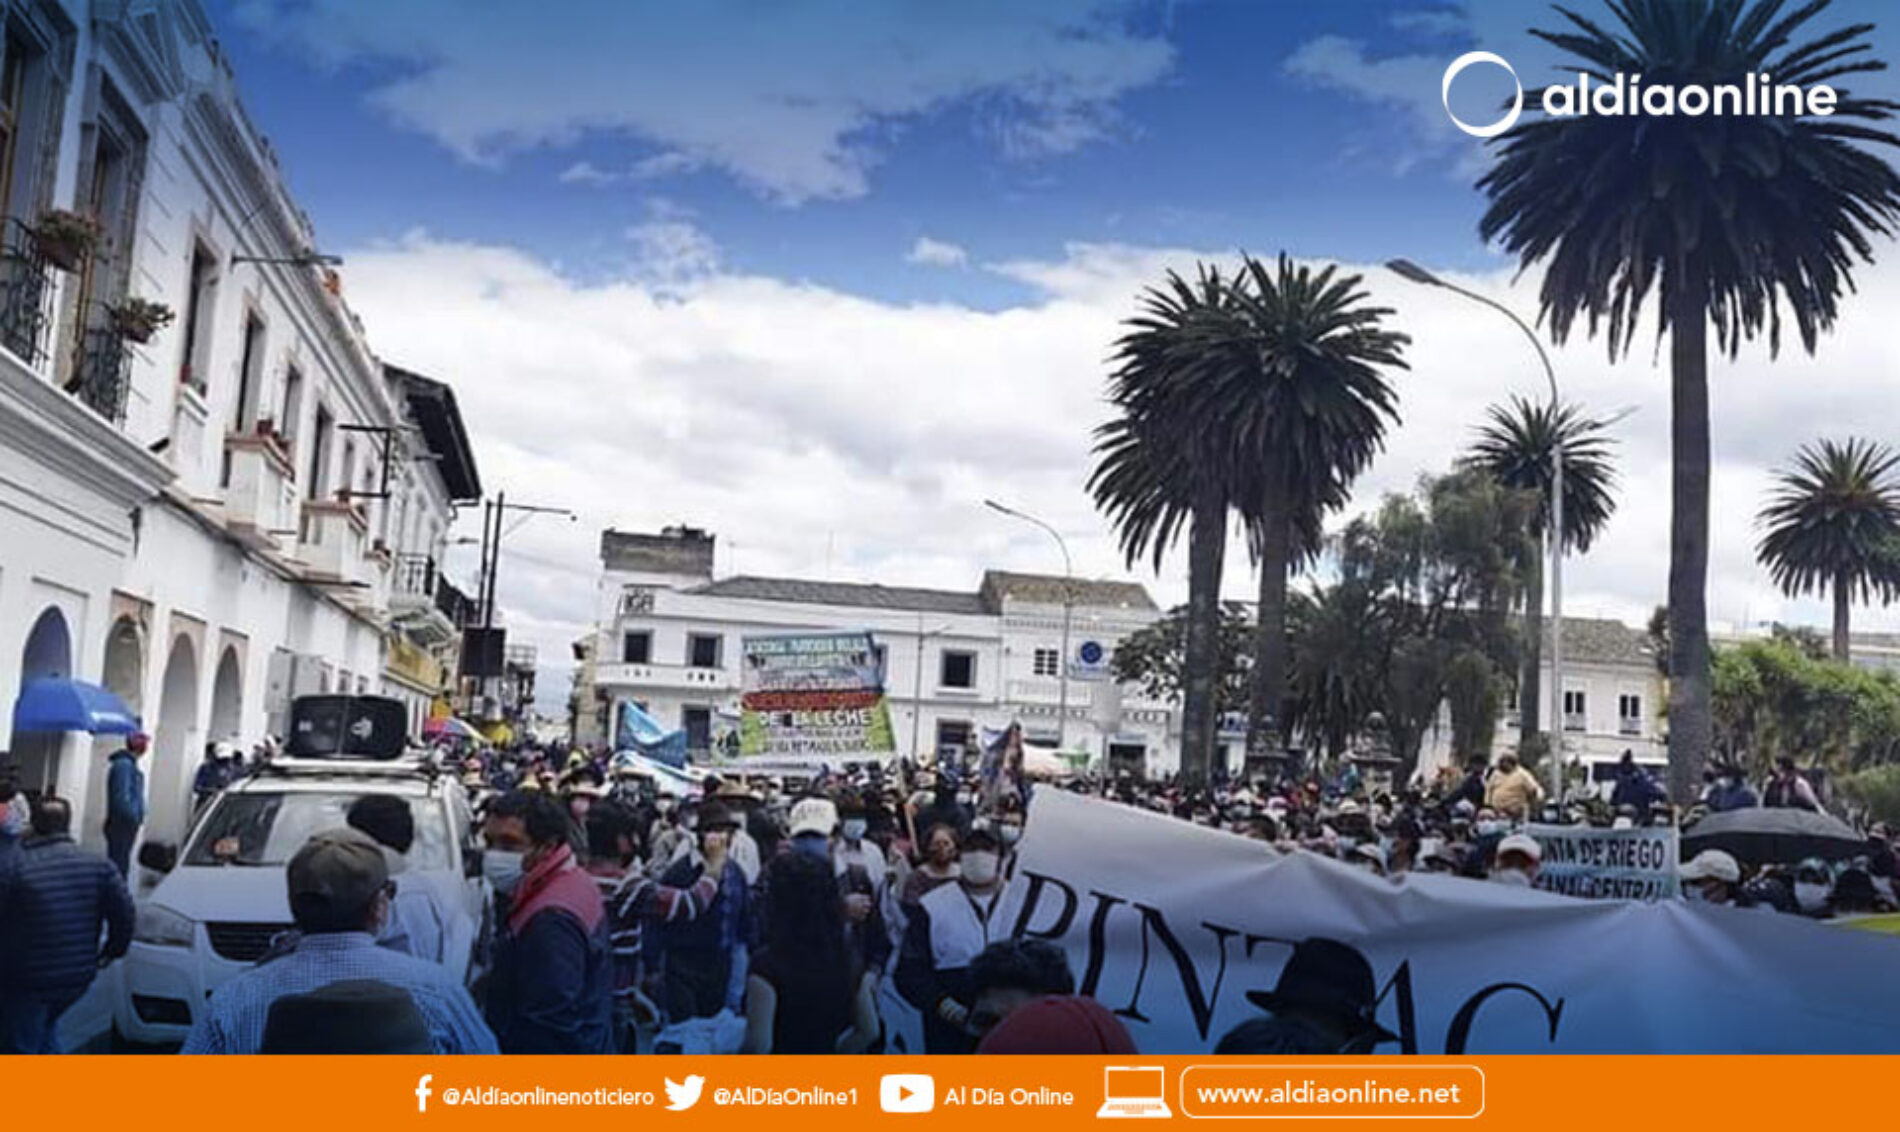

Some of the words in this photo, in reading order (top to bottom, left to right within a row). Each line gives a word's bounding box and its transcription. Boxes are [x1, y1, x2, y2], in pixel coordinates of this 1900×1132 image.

[814, 708, 873, 726] LECHE
[1579, 838, 1603, 866] DE
[1606, 838, 1665, 870] RIEGO
